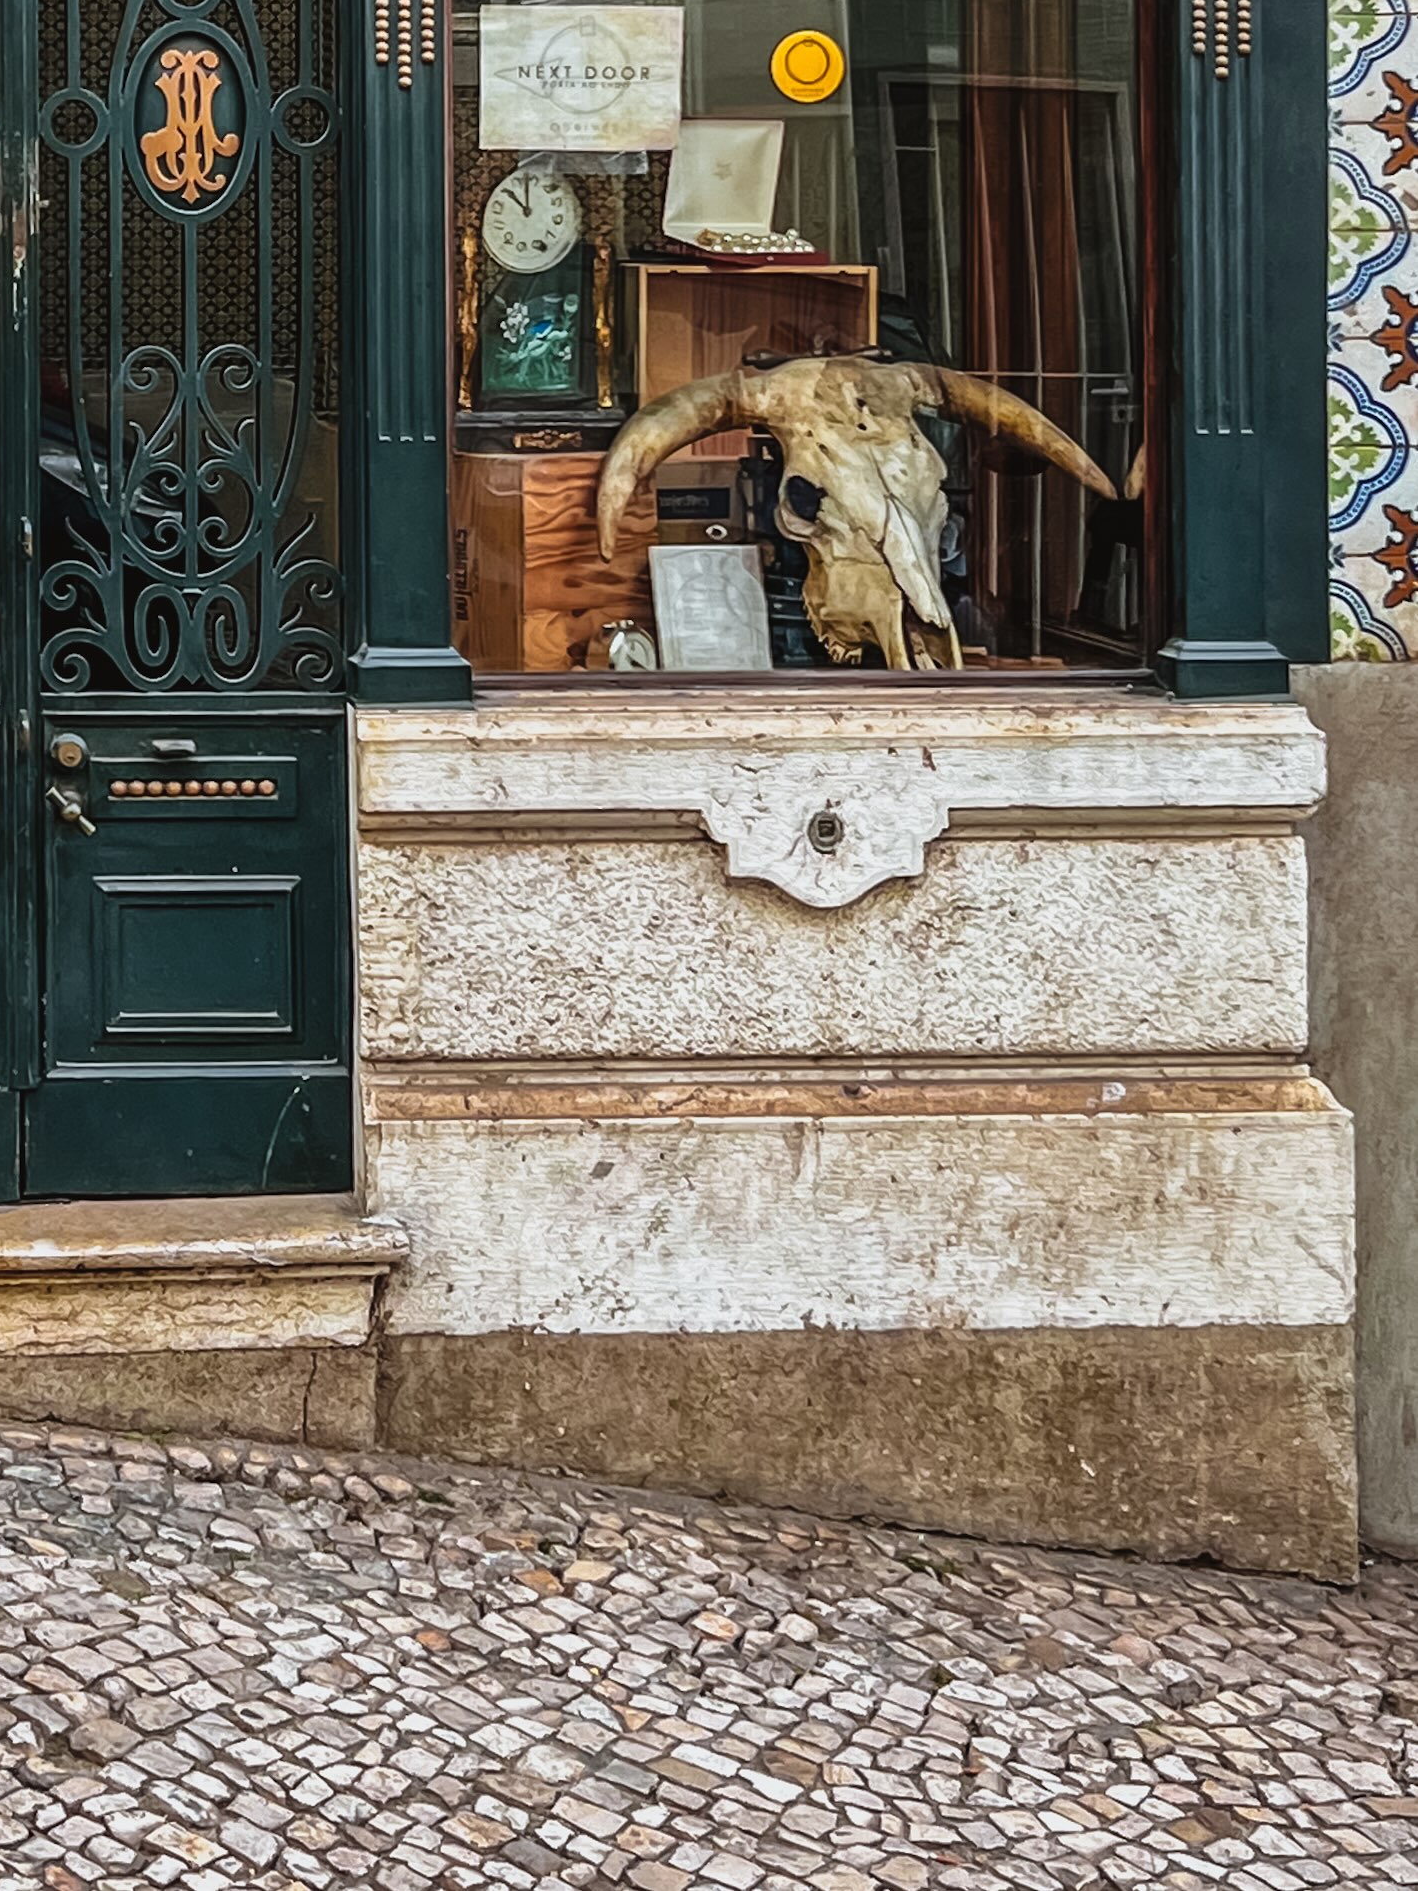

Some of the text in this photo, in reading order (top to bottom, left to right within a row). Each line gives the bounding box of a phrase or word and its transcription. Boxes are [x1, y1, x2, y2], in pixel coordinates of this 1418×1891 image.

[518, 65, 650, 81] NEXT DOOR
[552, 213, 564, 225] 6
